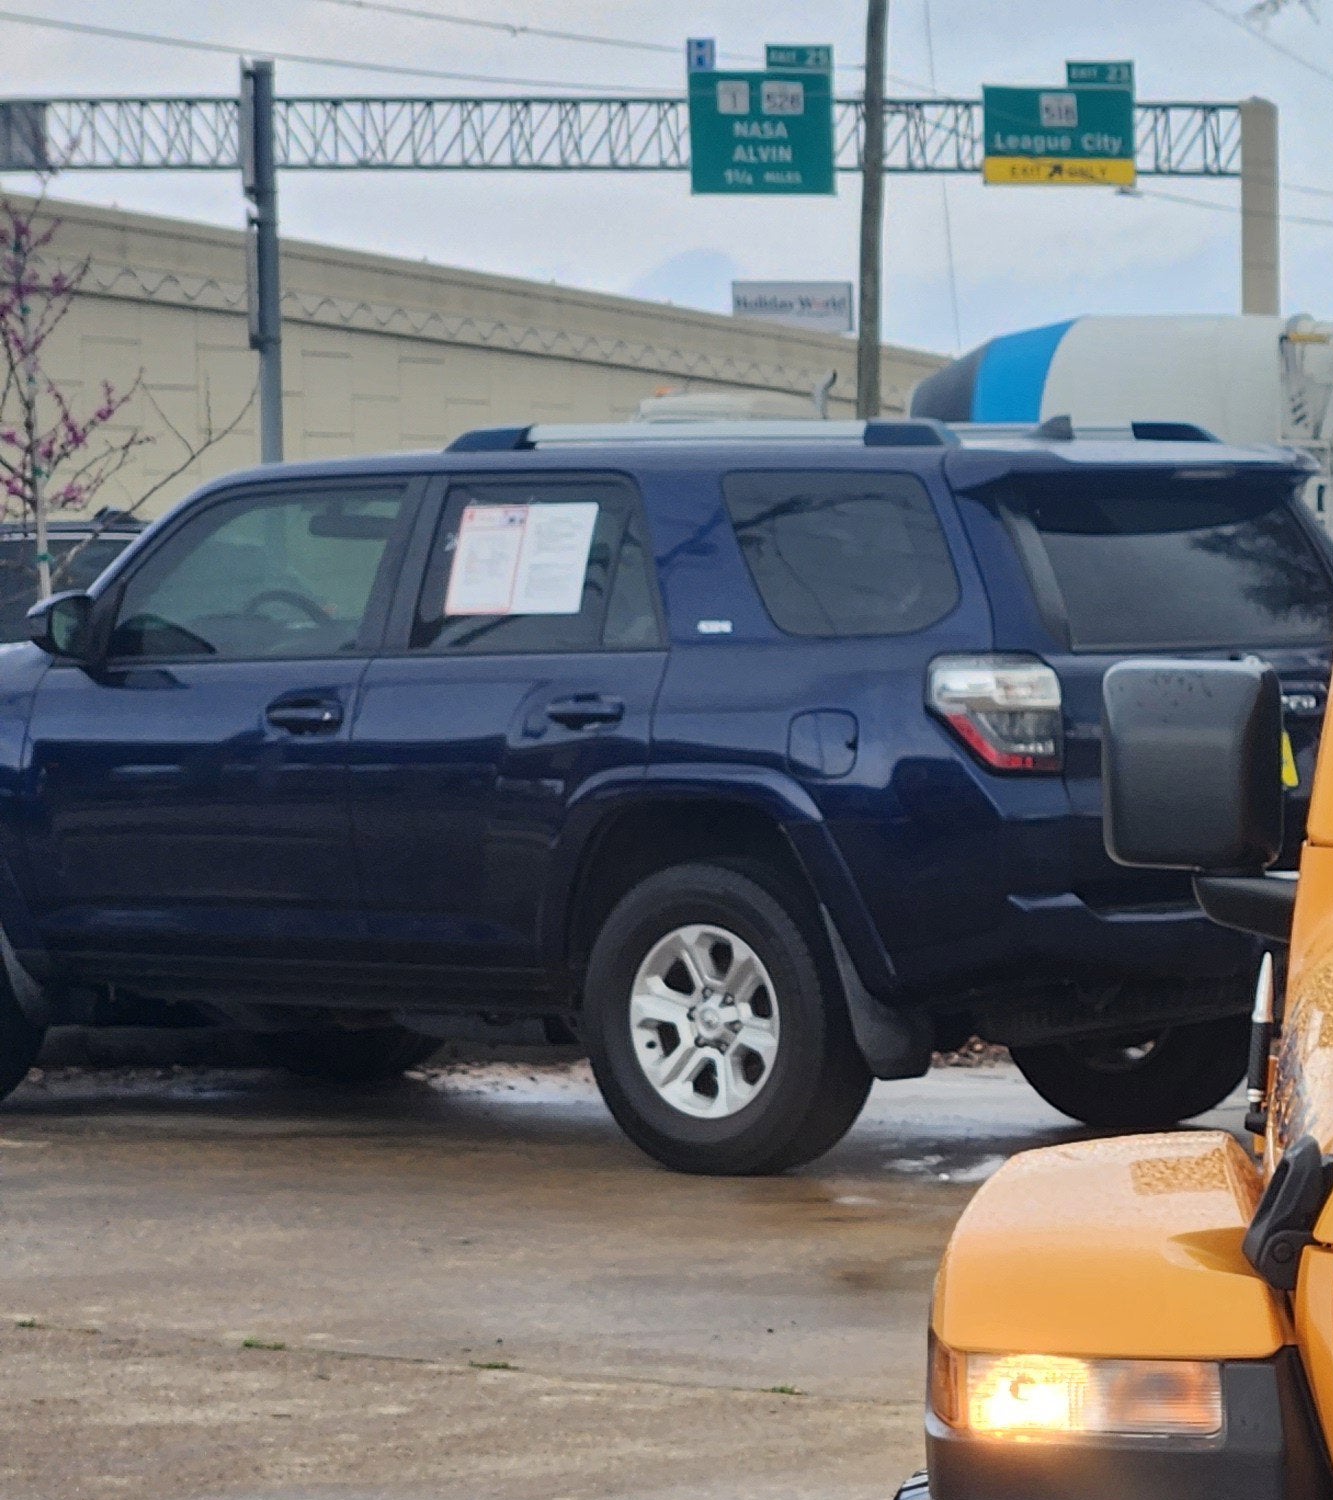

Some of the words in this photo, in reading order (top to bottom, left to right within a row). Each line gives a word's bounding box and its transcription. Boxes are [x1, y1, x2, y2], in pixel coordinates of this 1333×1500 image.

[733, 120, 788, 139] NASA
[733, 143, 793, 163] ALVIN
[994, 131, 1072, 155] League
[1081, 131, 1123, 156] City
[1010, 165, 1041, 178] EXIT
